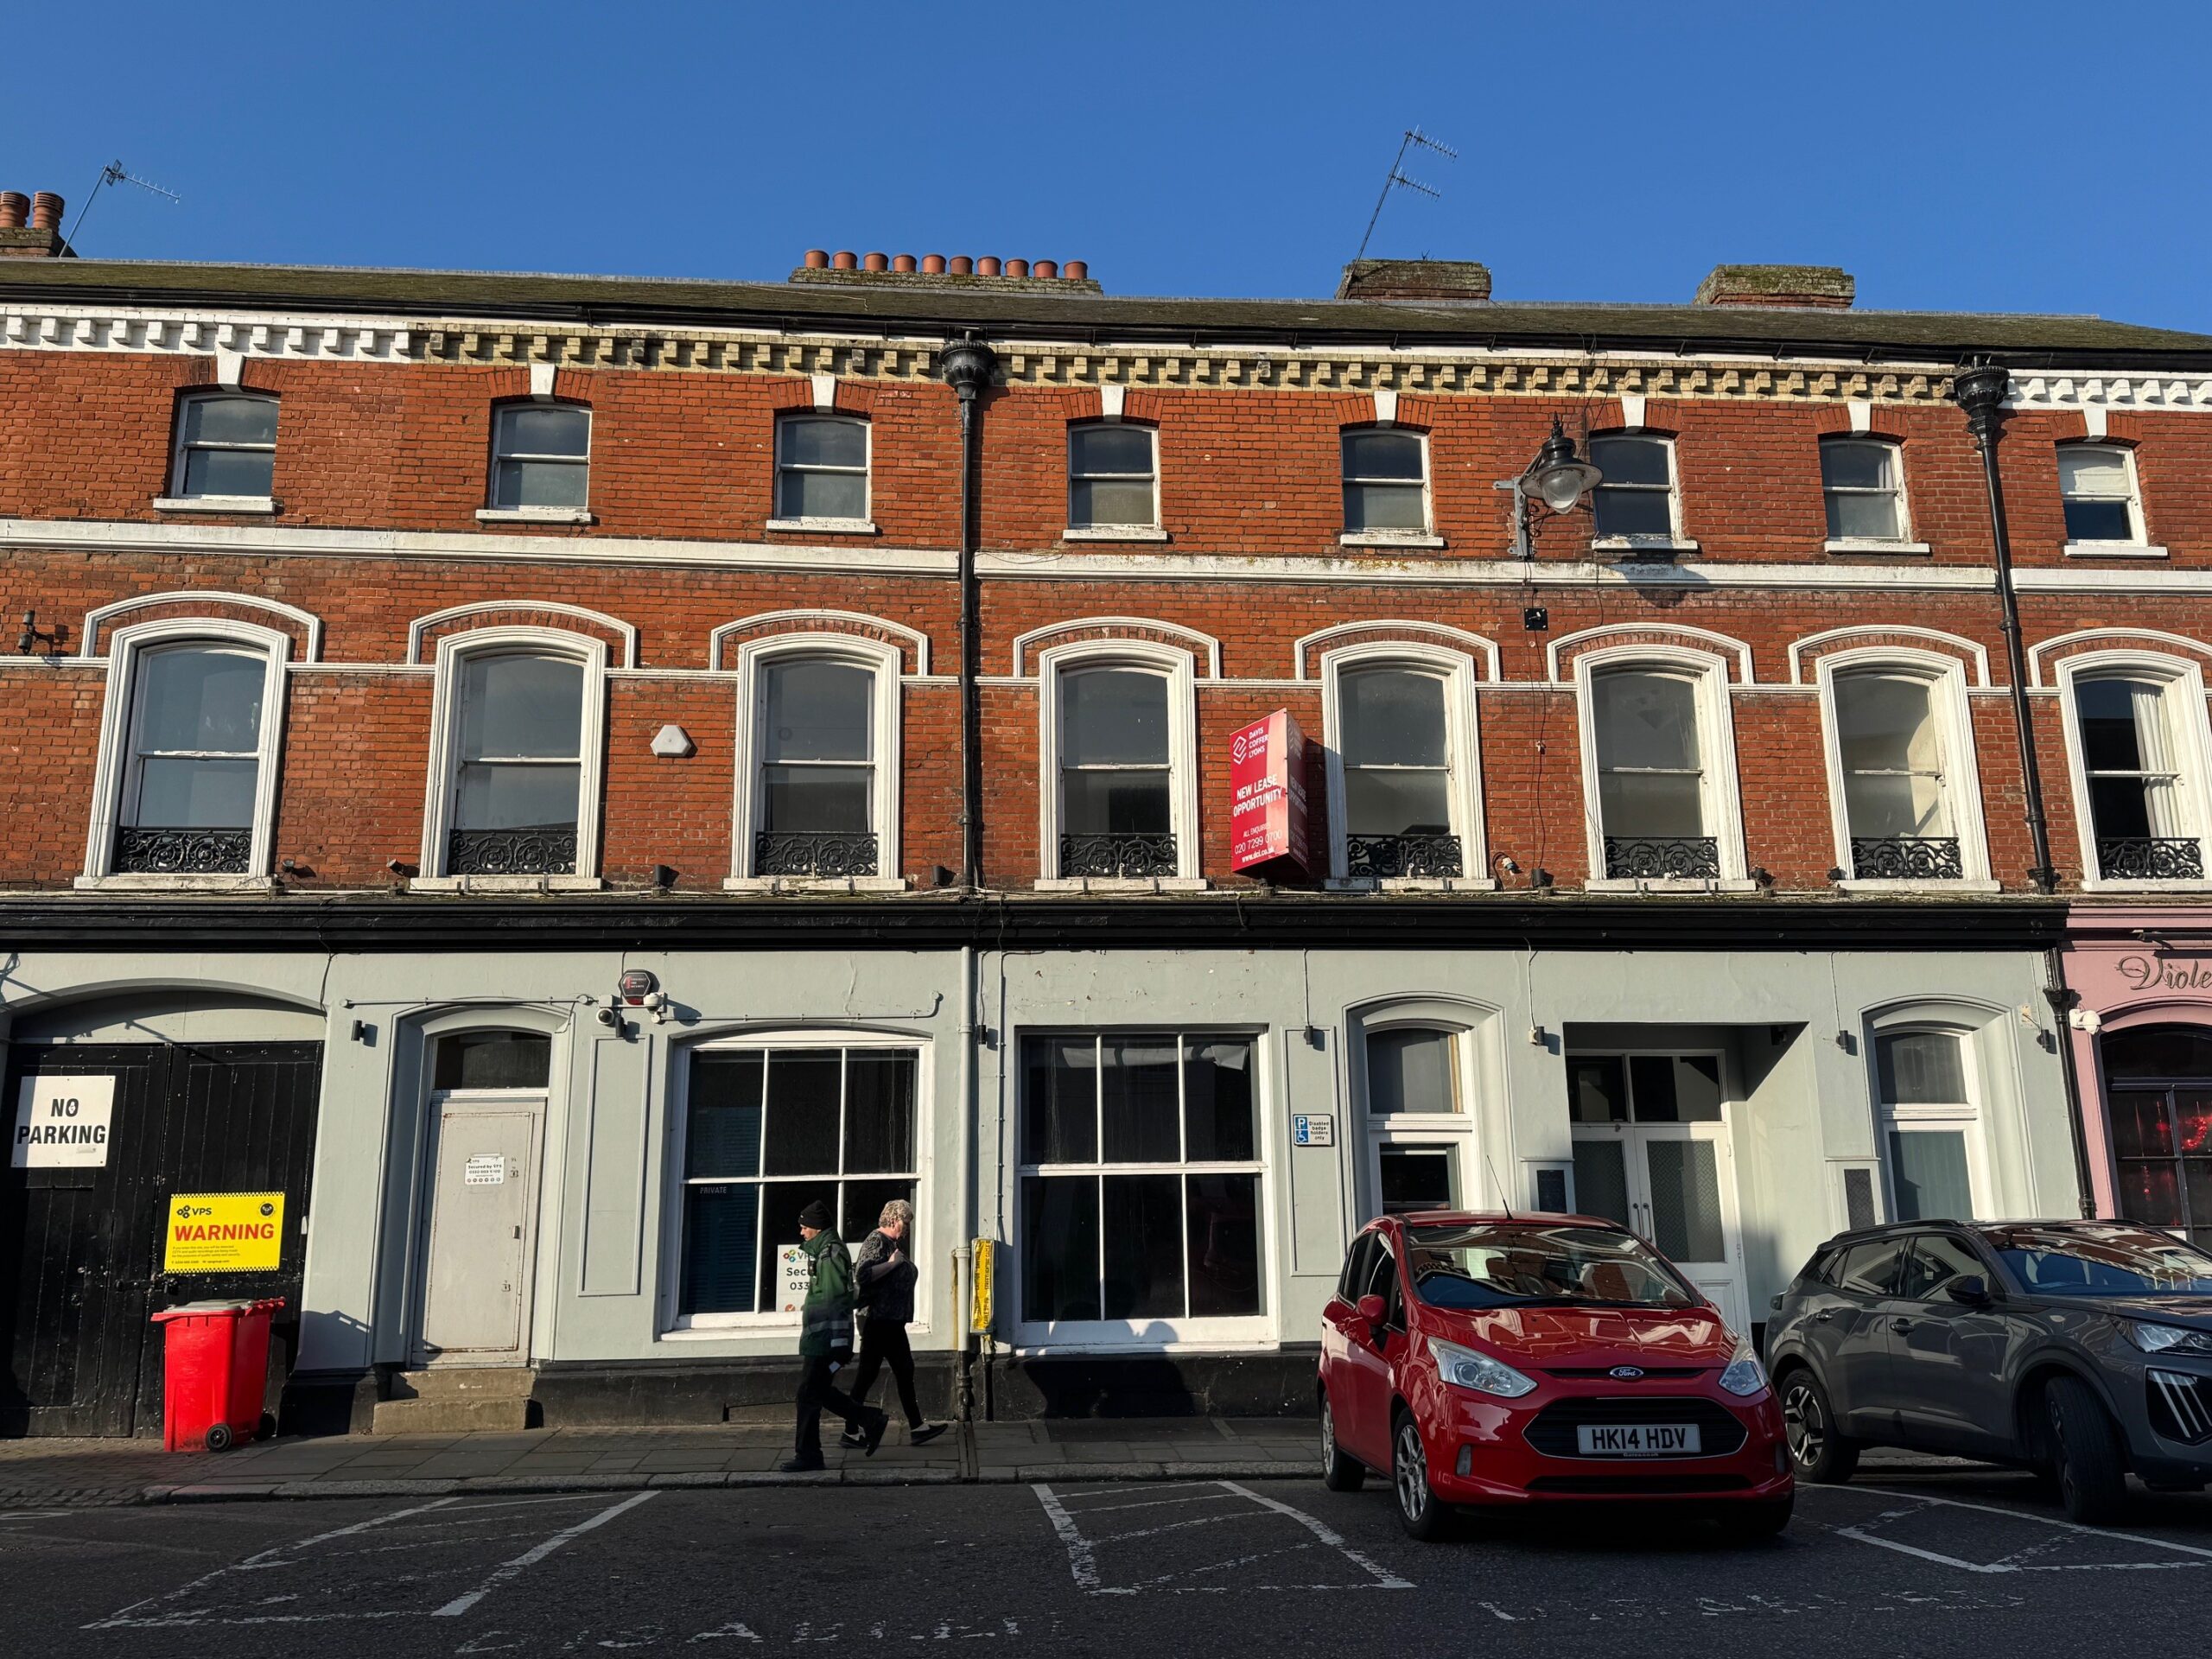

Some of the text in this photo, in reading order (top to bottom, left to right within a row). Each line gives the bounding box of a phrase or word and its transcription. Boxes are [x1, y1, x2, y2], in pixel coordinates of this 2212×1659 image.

[1236, 773, 1277, 801] NEW LEASE
[1233, 787, 1282, 817] OPPORTUNITY
[1234, 842, 1246, 855] 020
[1248, 836, 1264, 849] 7299
[51, 1098, 79, 1117] NO
[17, 1125, 106, 1145] PARKING
[192, 1207, 213, 1217] VPS
[175, 1223, 274, 1241] WARNING
[786, 1267, 809, 1276] Sec
[790, 1281, 810, 1290] 033
[1592, 1427, 1686, 1449] HK14 HDV
